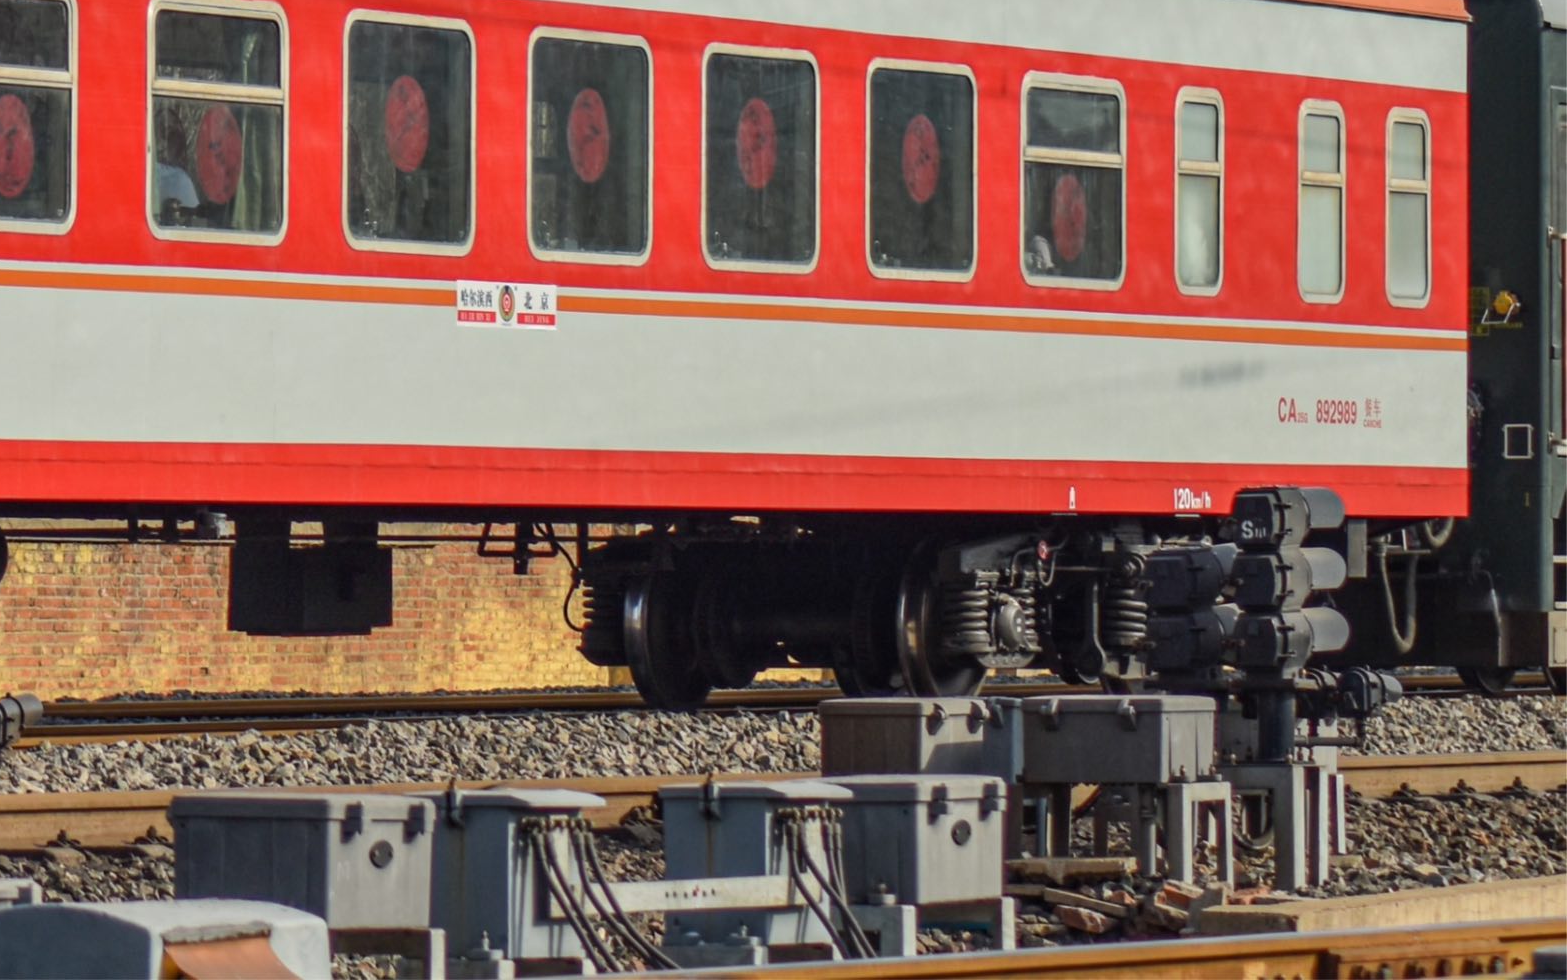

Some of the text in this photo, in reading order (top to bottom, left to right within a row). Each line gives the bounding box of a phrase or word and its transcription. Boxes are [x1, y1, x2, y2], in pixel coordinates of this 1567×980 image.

[461, 288, 550, 310] 哈尔滨西 北京
[1316, 399, 1358, 425] 892989
